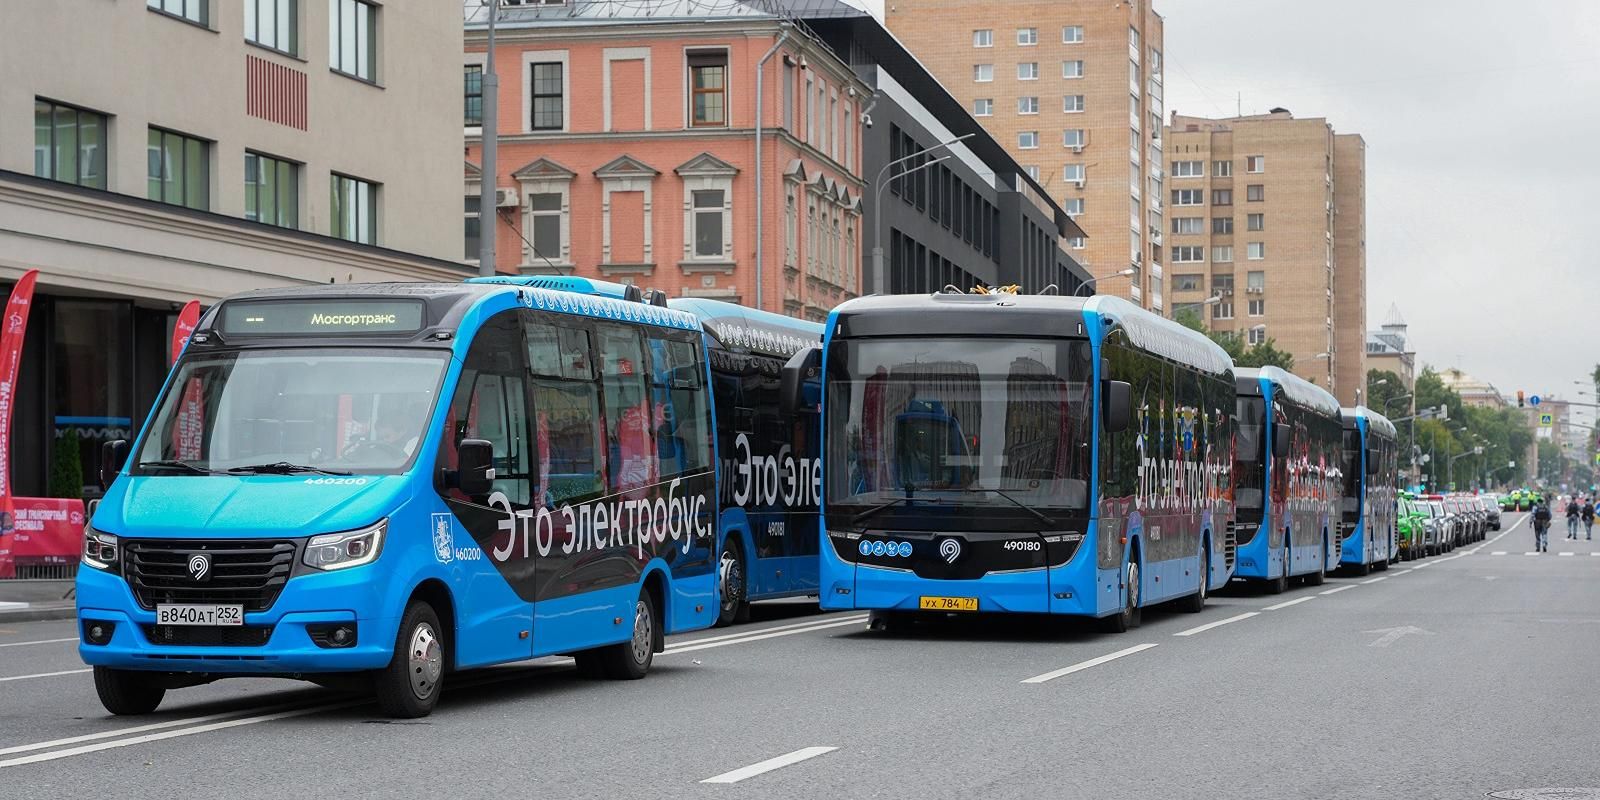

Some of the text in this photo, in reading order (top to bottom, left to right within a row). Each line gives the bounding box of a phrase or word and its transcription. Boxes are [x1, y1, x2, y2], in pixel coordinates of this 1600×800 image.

[311, 313, 395, 326] Мосгортранс
[734, 432, 821, 507] Это эле
[1135, 434, 1157, 510] Это
[303, 477, 367, 486] 460200
[487, 477, 712, 562] Это электробус.
[1003, 540, 1041, 552] 490180
[455, 547, 481, 561] 460200
[941, 598, 959, 609] 784
[965, 599, 974, 607] 77
[161, 607, 239, 623] В840АТ 252
